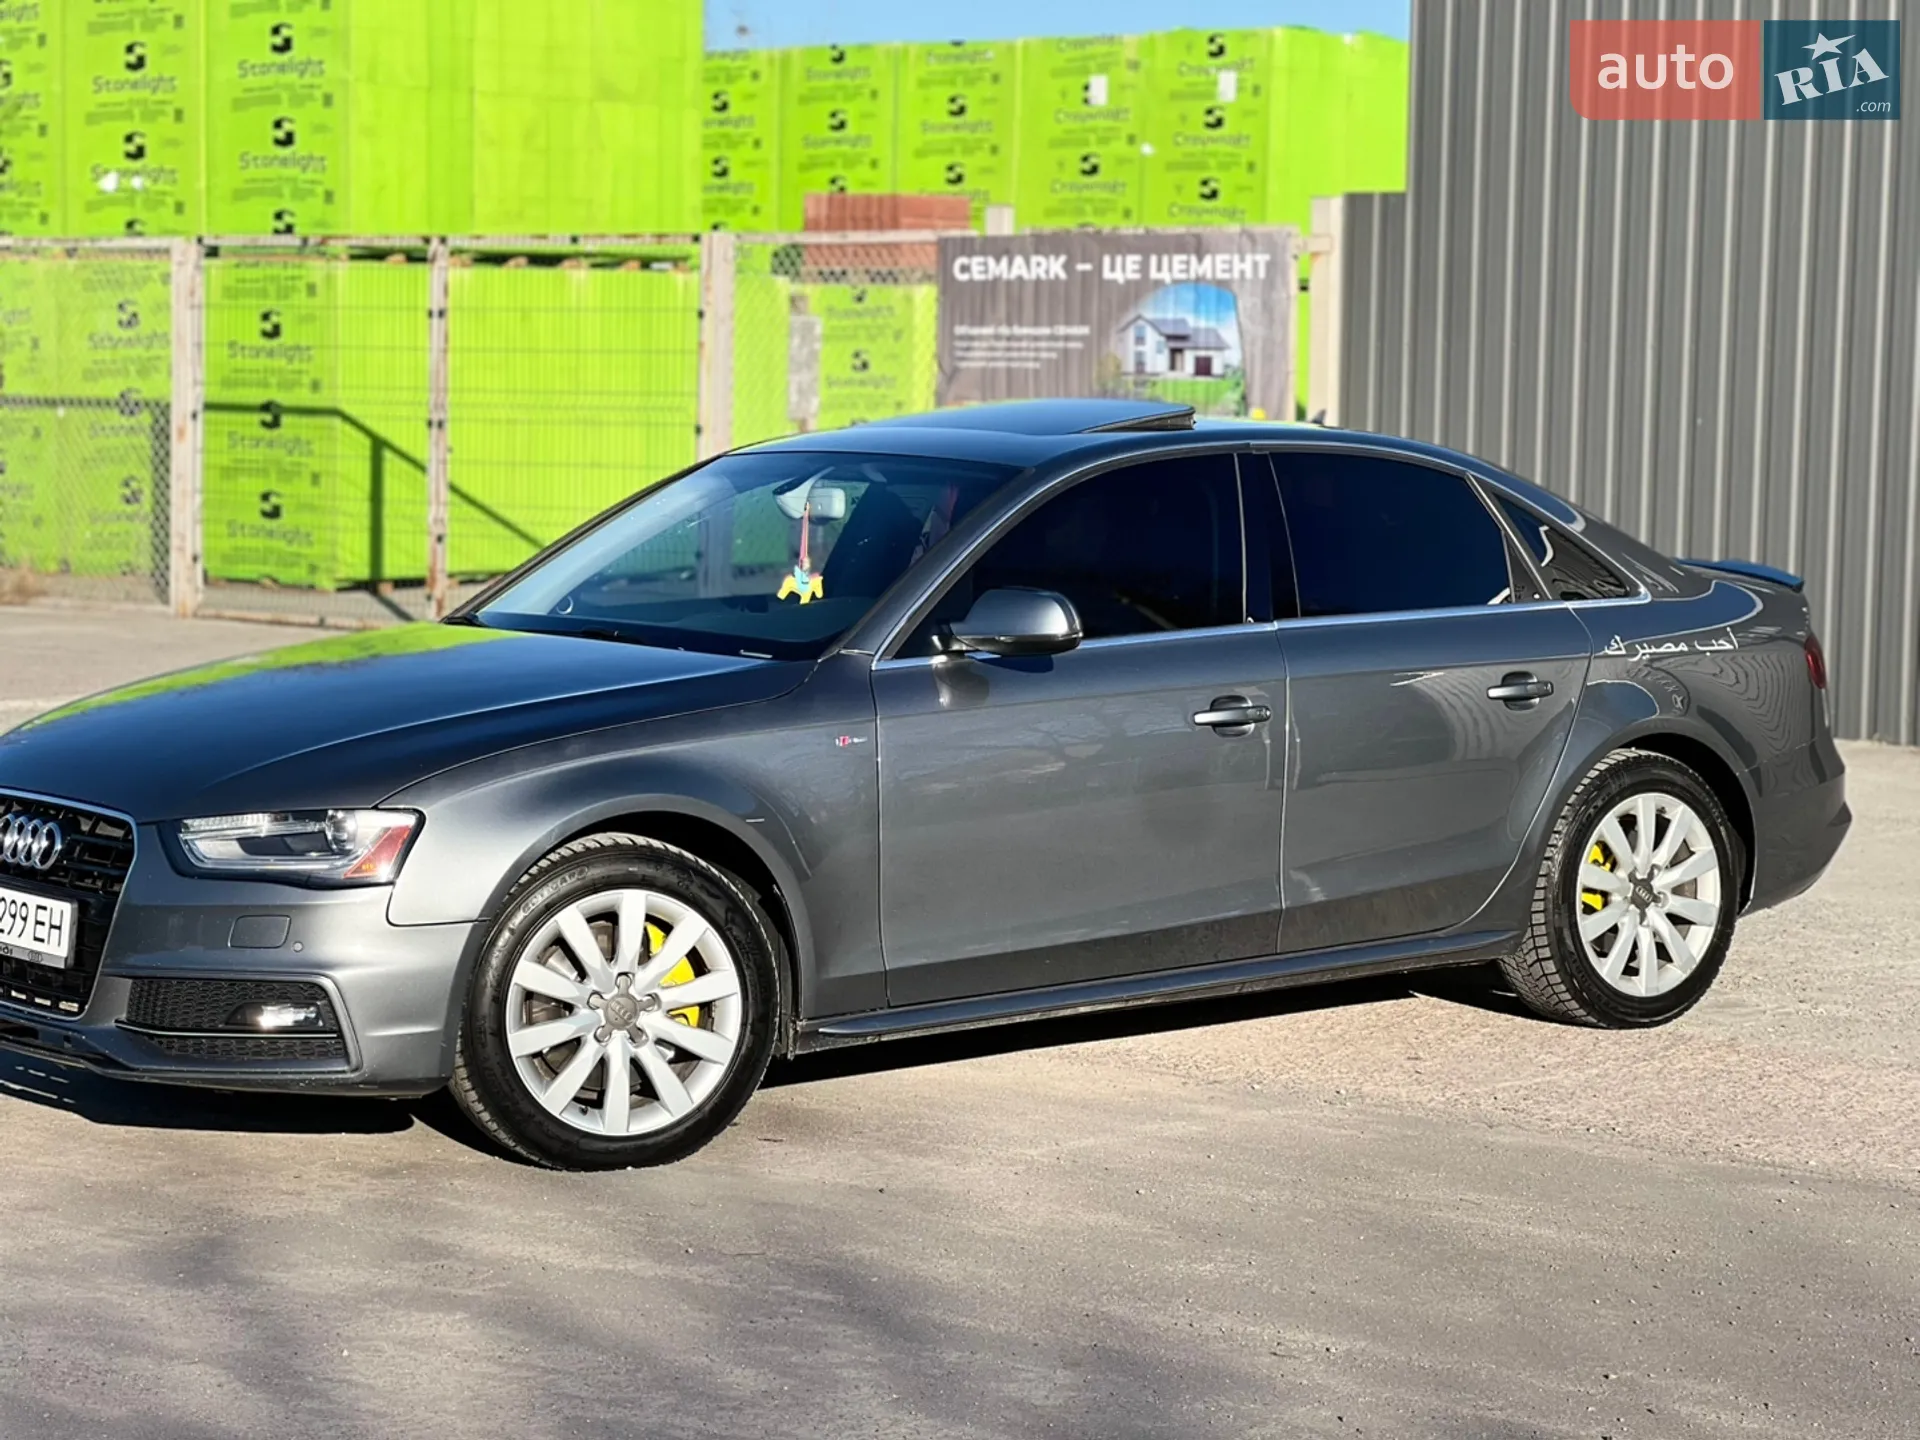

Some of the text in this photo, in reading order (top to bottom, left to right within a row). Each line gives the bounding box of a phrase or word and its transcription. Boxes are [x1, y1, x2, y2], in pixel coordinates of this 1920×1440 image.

[952, 254, 1068, 282] CEMARK
[1101, 253, 1143, 284] ЦЕ
[1149, 252, 1271, 284] ЦЕМЕНТ
[1694, 627, 1739, 657] أحب
[33, 904, 64, 947] EH
